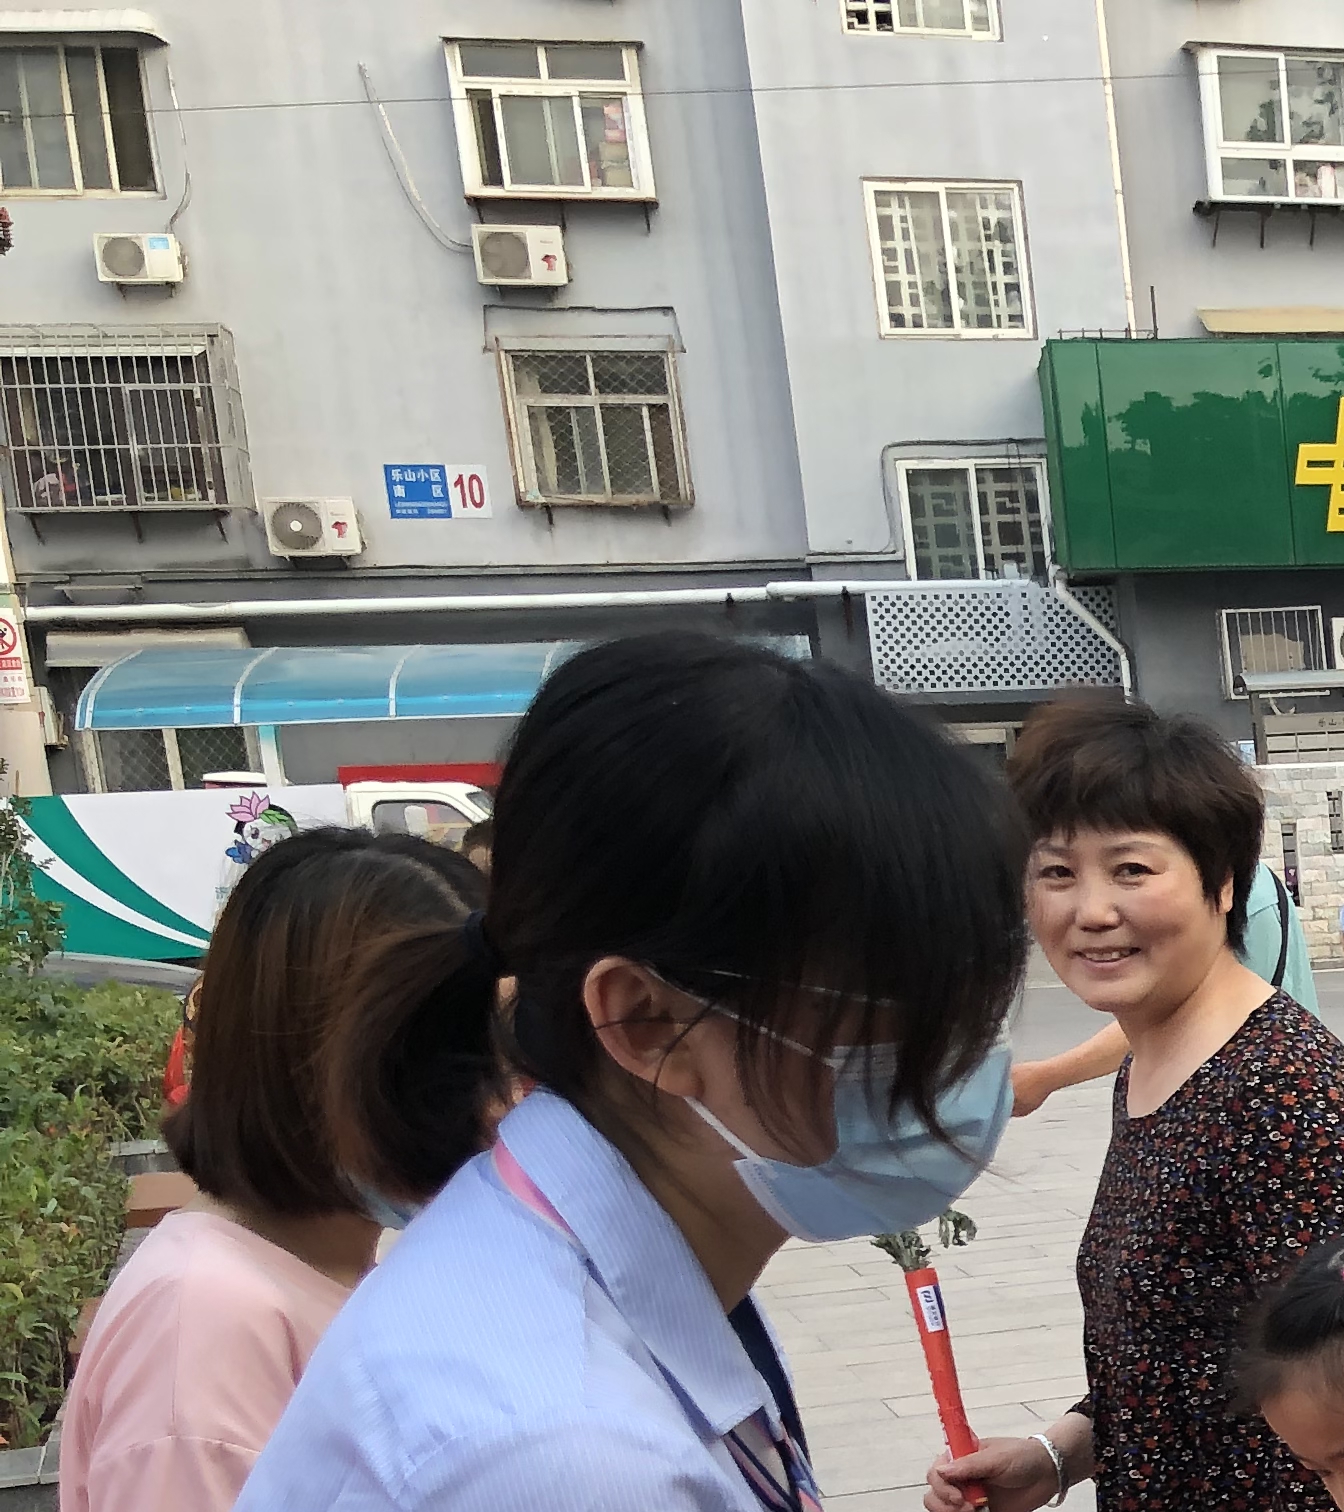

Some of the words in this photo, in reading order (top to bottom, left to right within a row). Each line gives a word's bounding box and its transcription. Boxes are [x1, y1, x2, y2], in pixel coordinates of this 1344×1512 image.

[391, 468, 442, 482] 乐山小区
[453, 473, 485, 509] 10
